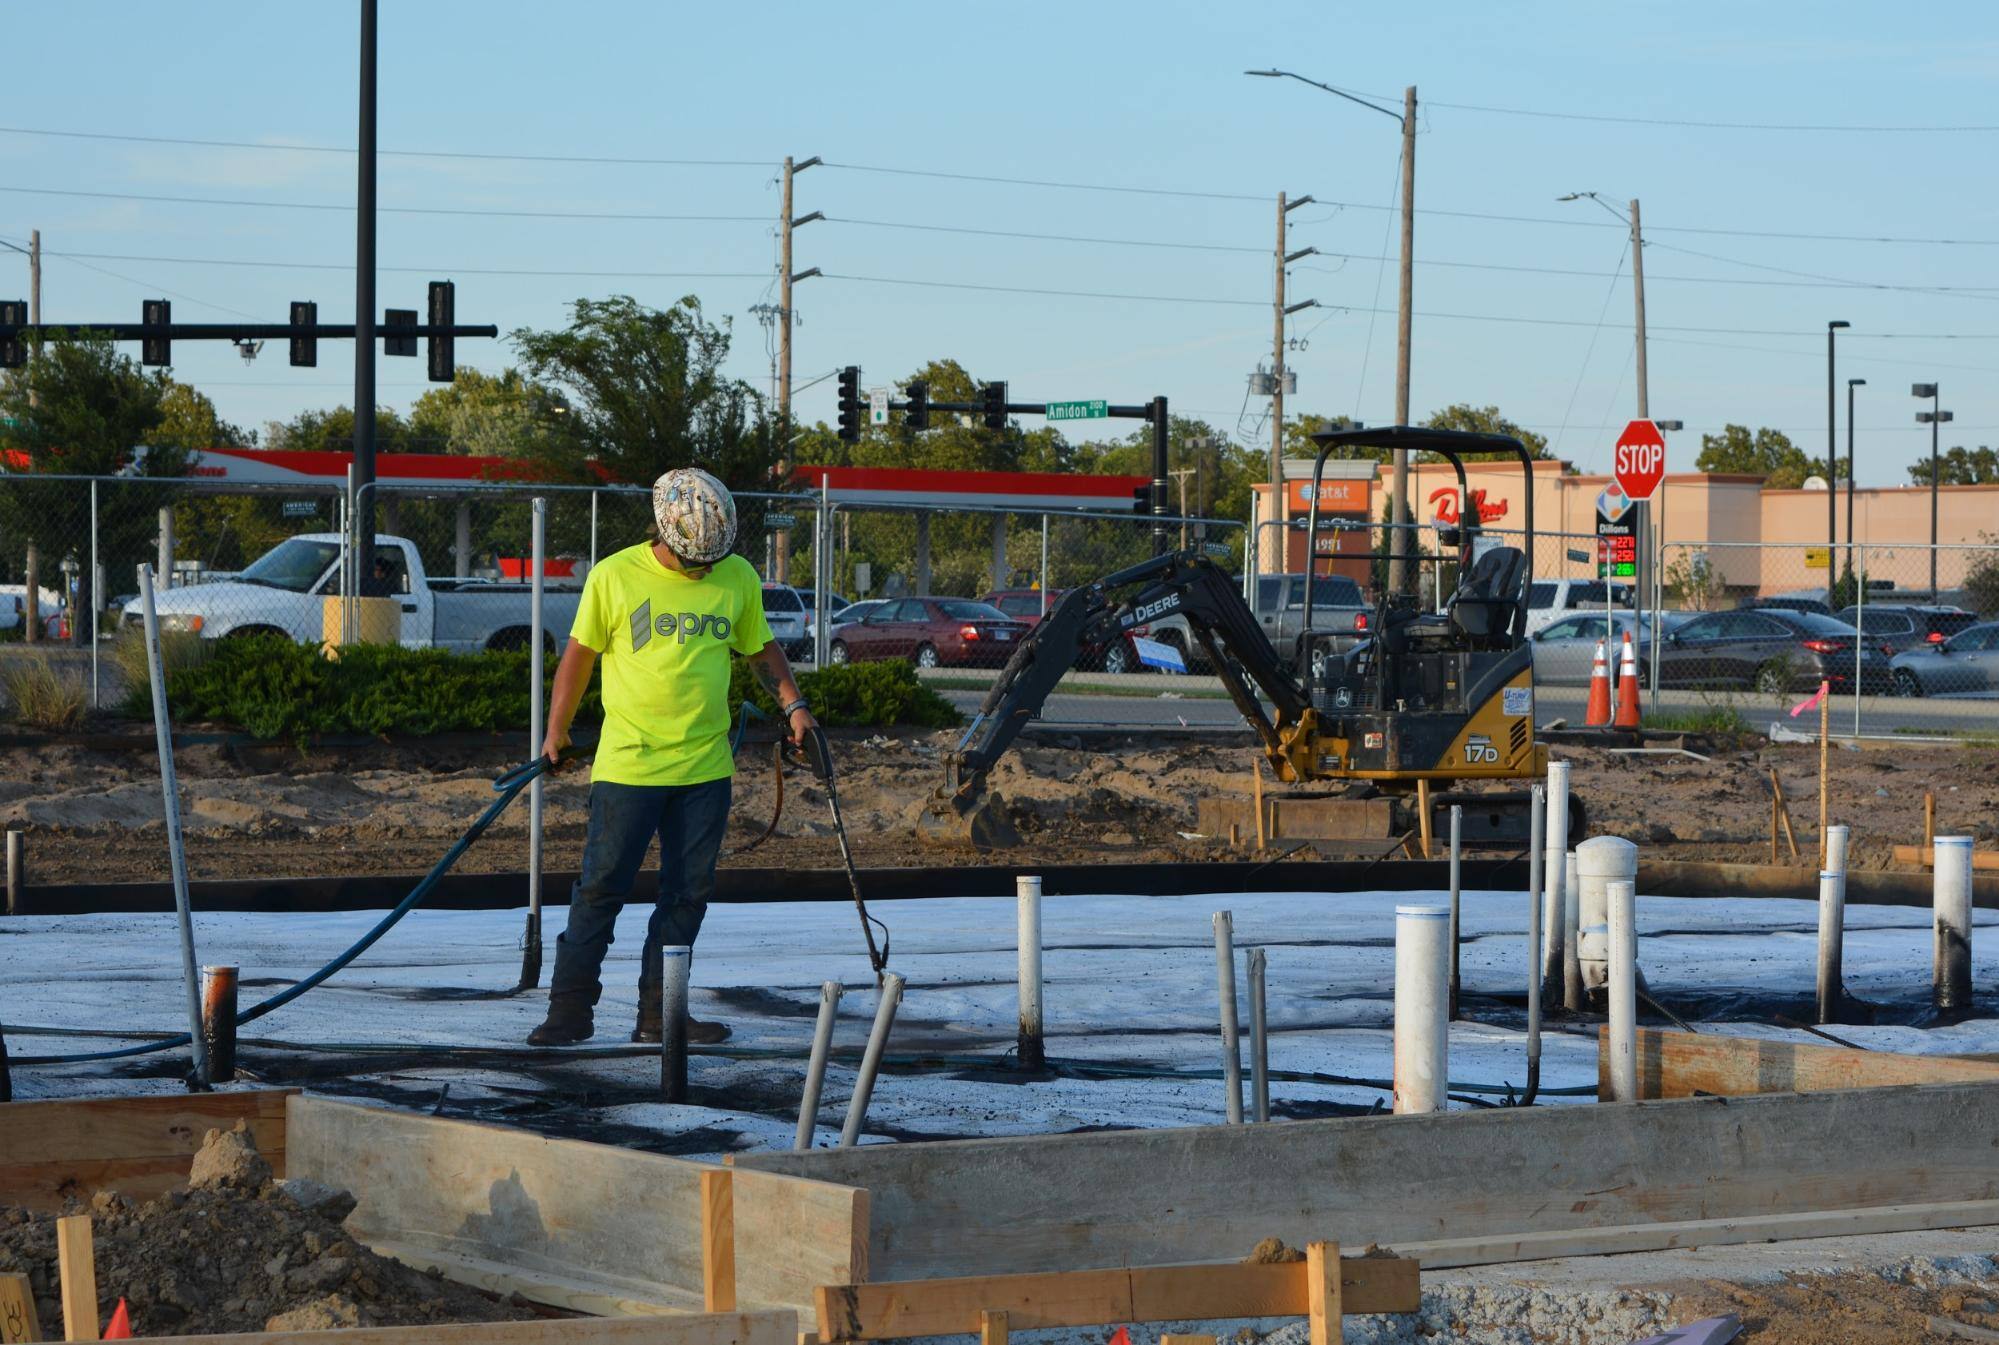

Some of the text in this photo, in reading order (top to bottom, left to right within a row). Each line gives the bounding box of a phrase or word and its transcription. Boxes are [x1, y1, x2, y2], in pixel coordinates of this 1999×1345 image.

[1049, 404, 1087, 419] Amidon
[1089, 400, 1104, 410] 2100
[1618, 444, 1662, 475] STOP
[1318, 485, 1350, 500] at&t
[1600, 524, 1629, 534] Dillons
[1135, 592, 1181, 622] DEERE
[655, 613, 731, 644] epro
[1465, 745, 1498, 762] 17D
